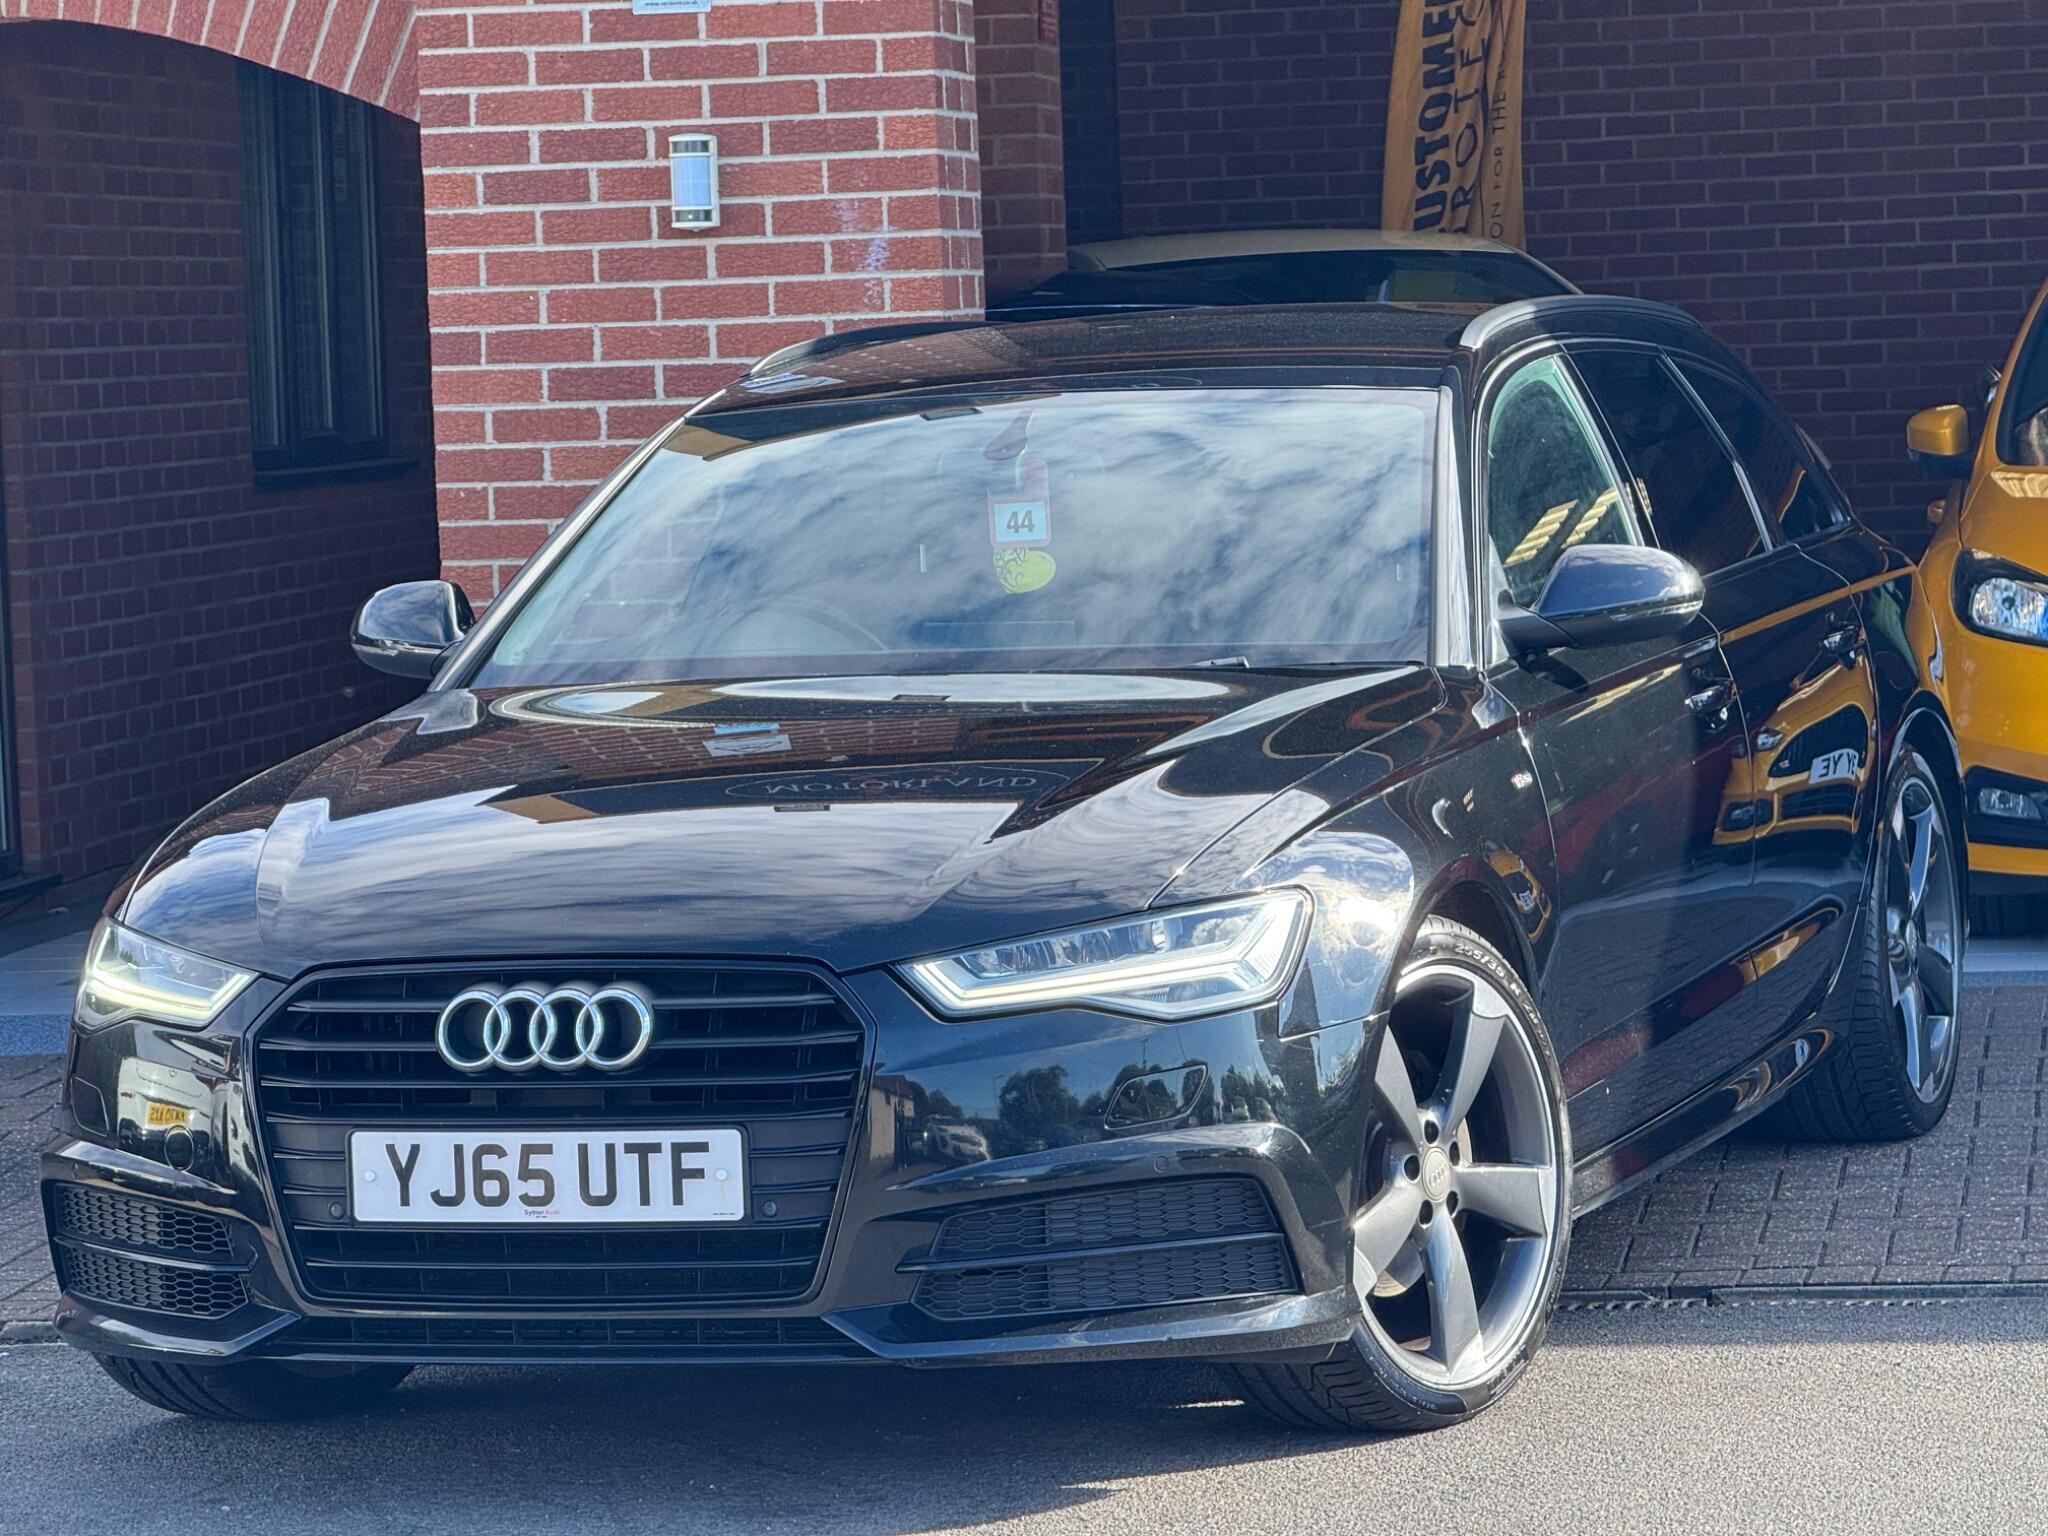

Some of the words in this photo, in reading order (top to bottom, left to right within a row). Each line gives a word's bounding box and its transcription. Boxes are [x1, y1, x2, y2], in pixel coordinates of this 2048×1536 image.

[1412, 0, 1459, 231] USTOME
[1006, 510, 1035, 533] 44
[384, 1143, 555, 1207] YJ65
[577, 1141, 710, 1207] UTF
